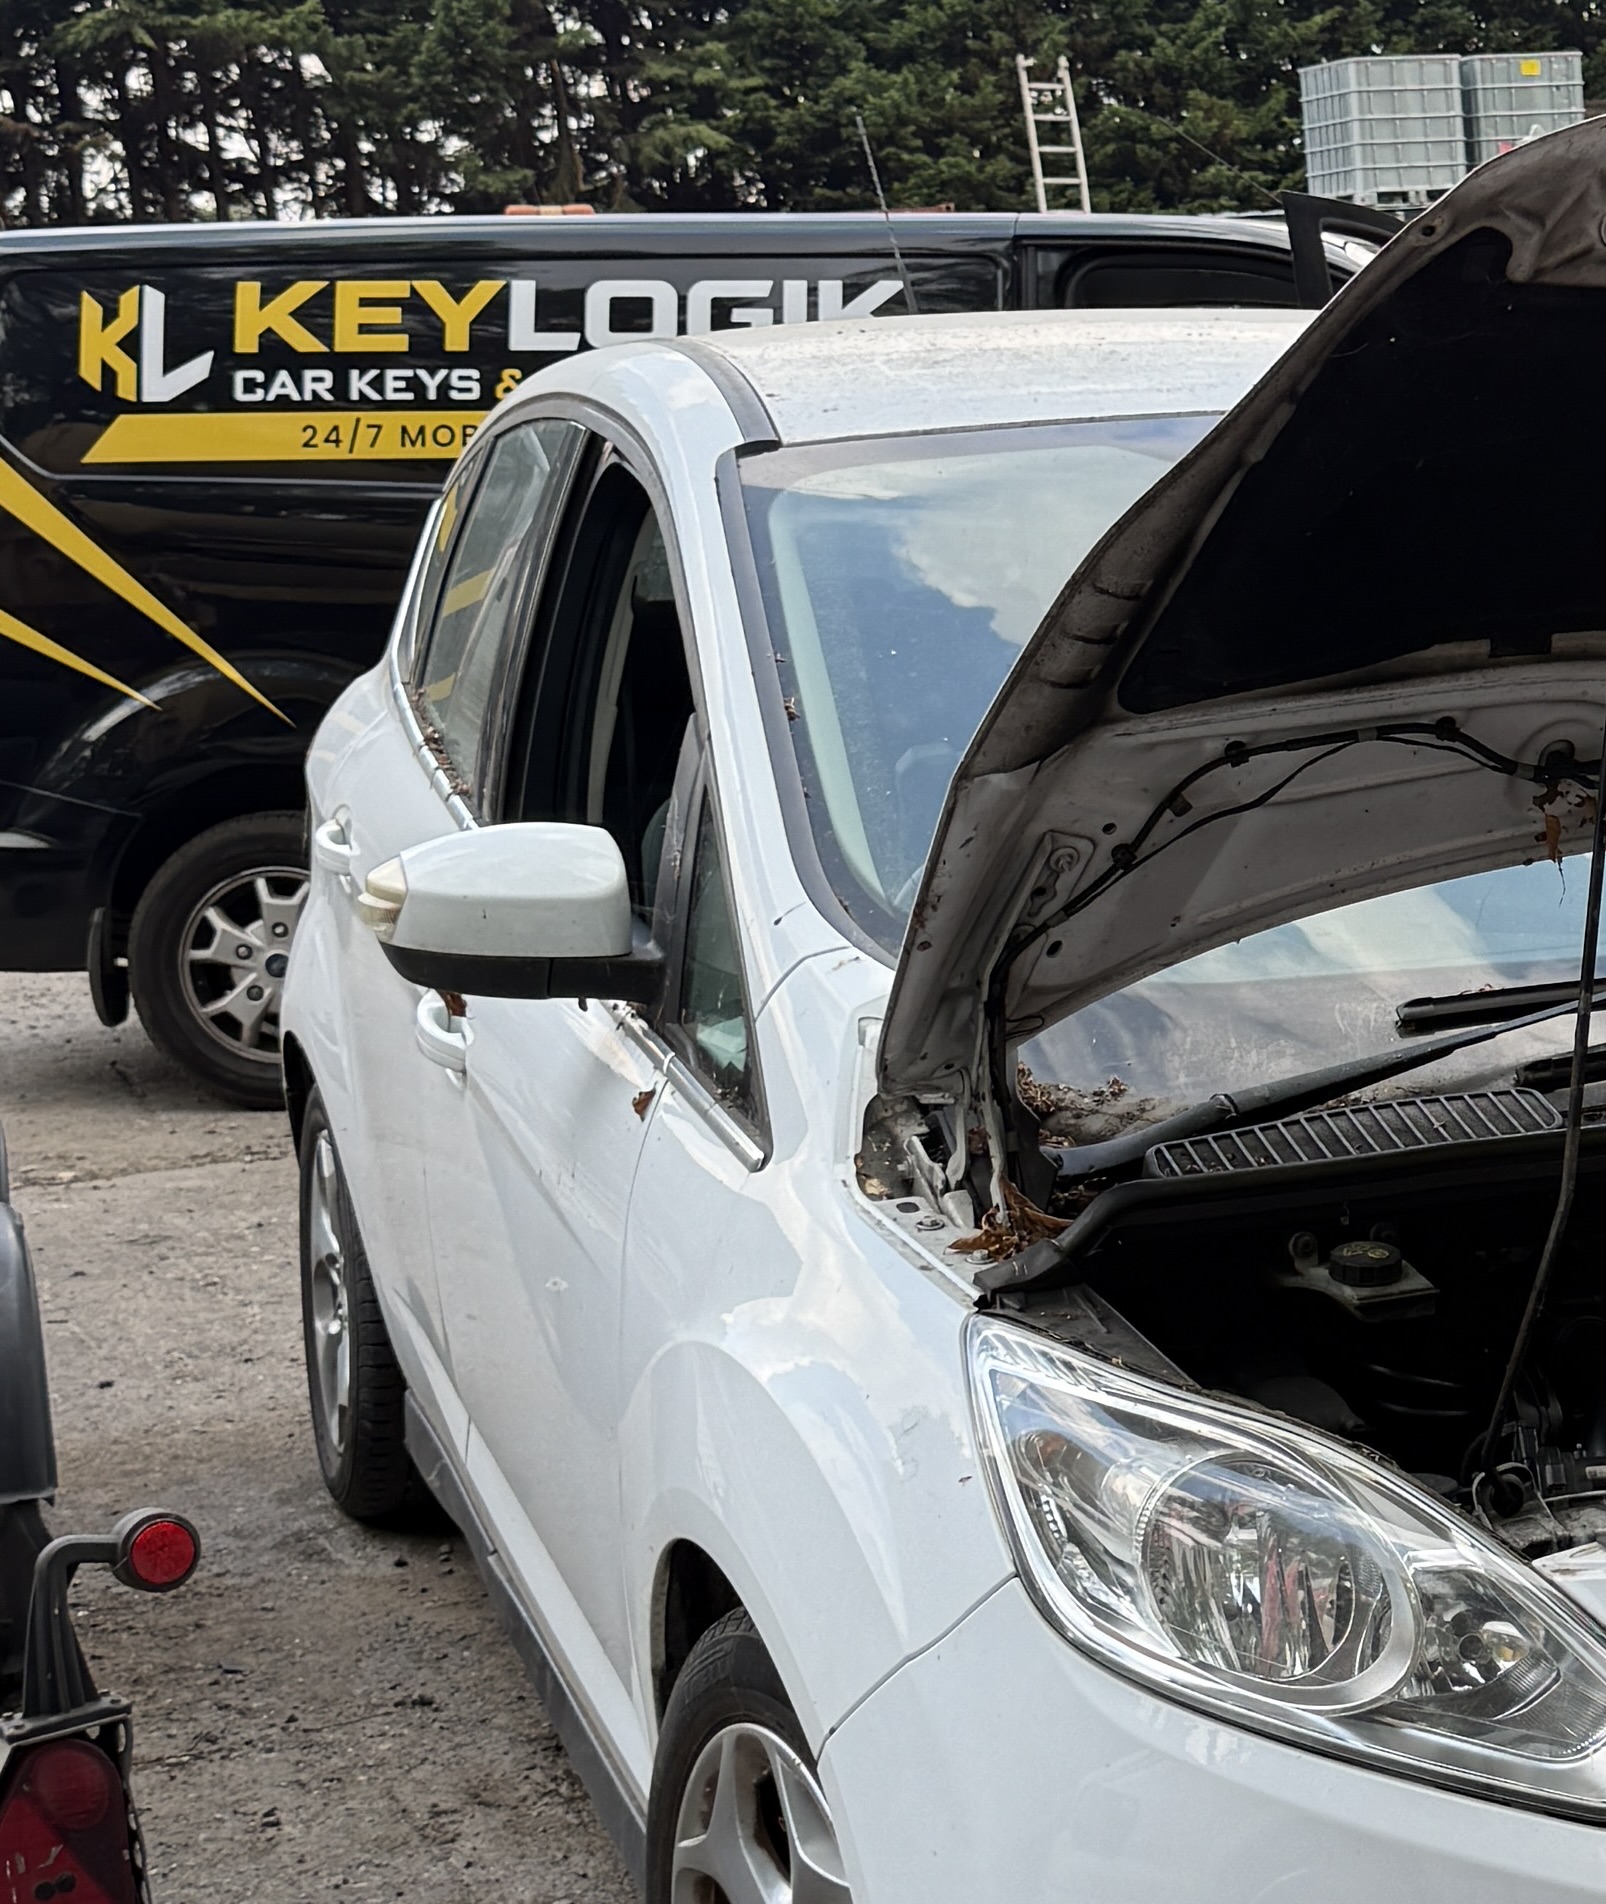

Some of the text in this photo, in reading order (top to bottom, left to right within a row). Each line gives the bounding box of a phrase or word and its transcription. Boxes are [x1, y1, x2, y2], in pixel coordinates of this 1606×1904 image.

[233, 368, 334, 402] CAR
[349, 368, 482, 402] KEYS
[301, 417, 384, 454] 24/7
